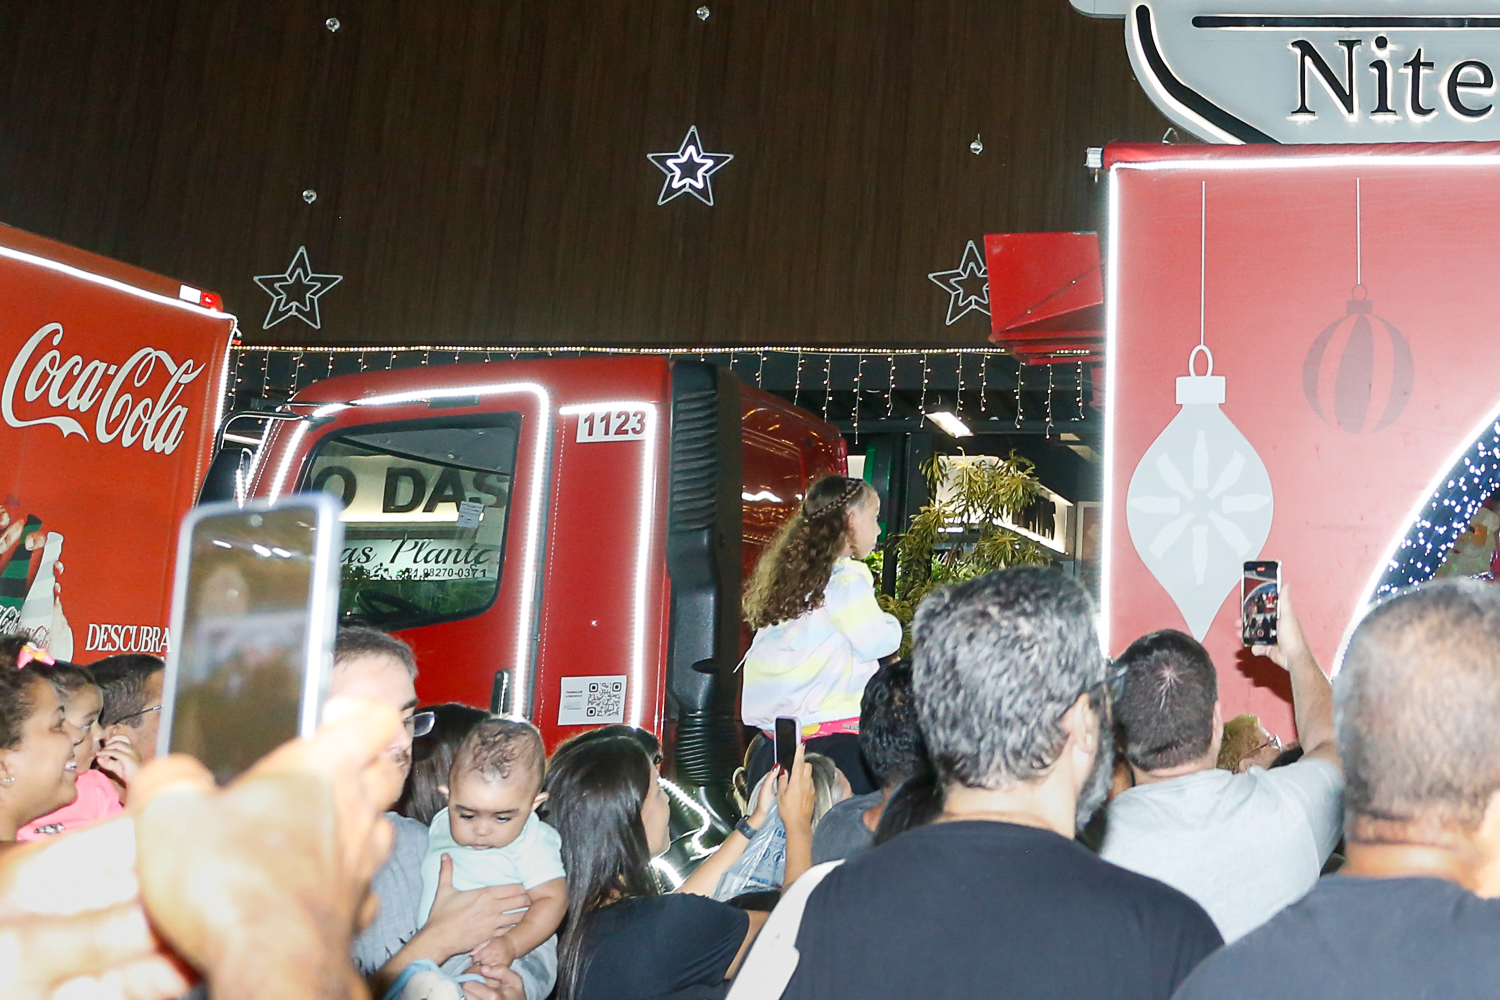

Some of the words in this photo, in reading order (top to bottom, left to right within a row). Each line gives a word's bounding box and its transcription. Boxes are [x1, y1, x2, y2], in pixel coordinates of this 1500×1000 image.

[1, 322, 206, 456] Coca-Cola
[583, 409, 646, 437] 1123
[382, 466, 509, 514] DAS
[85, 623, 172, 653] DESCUBRA
